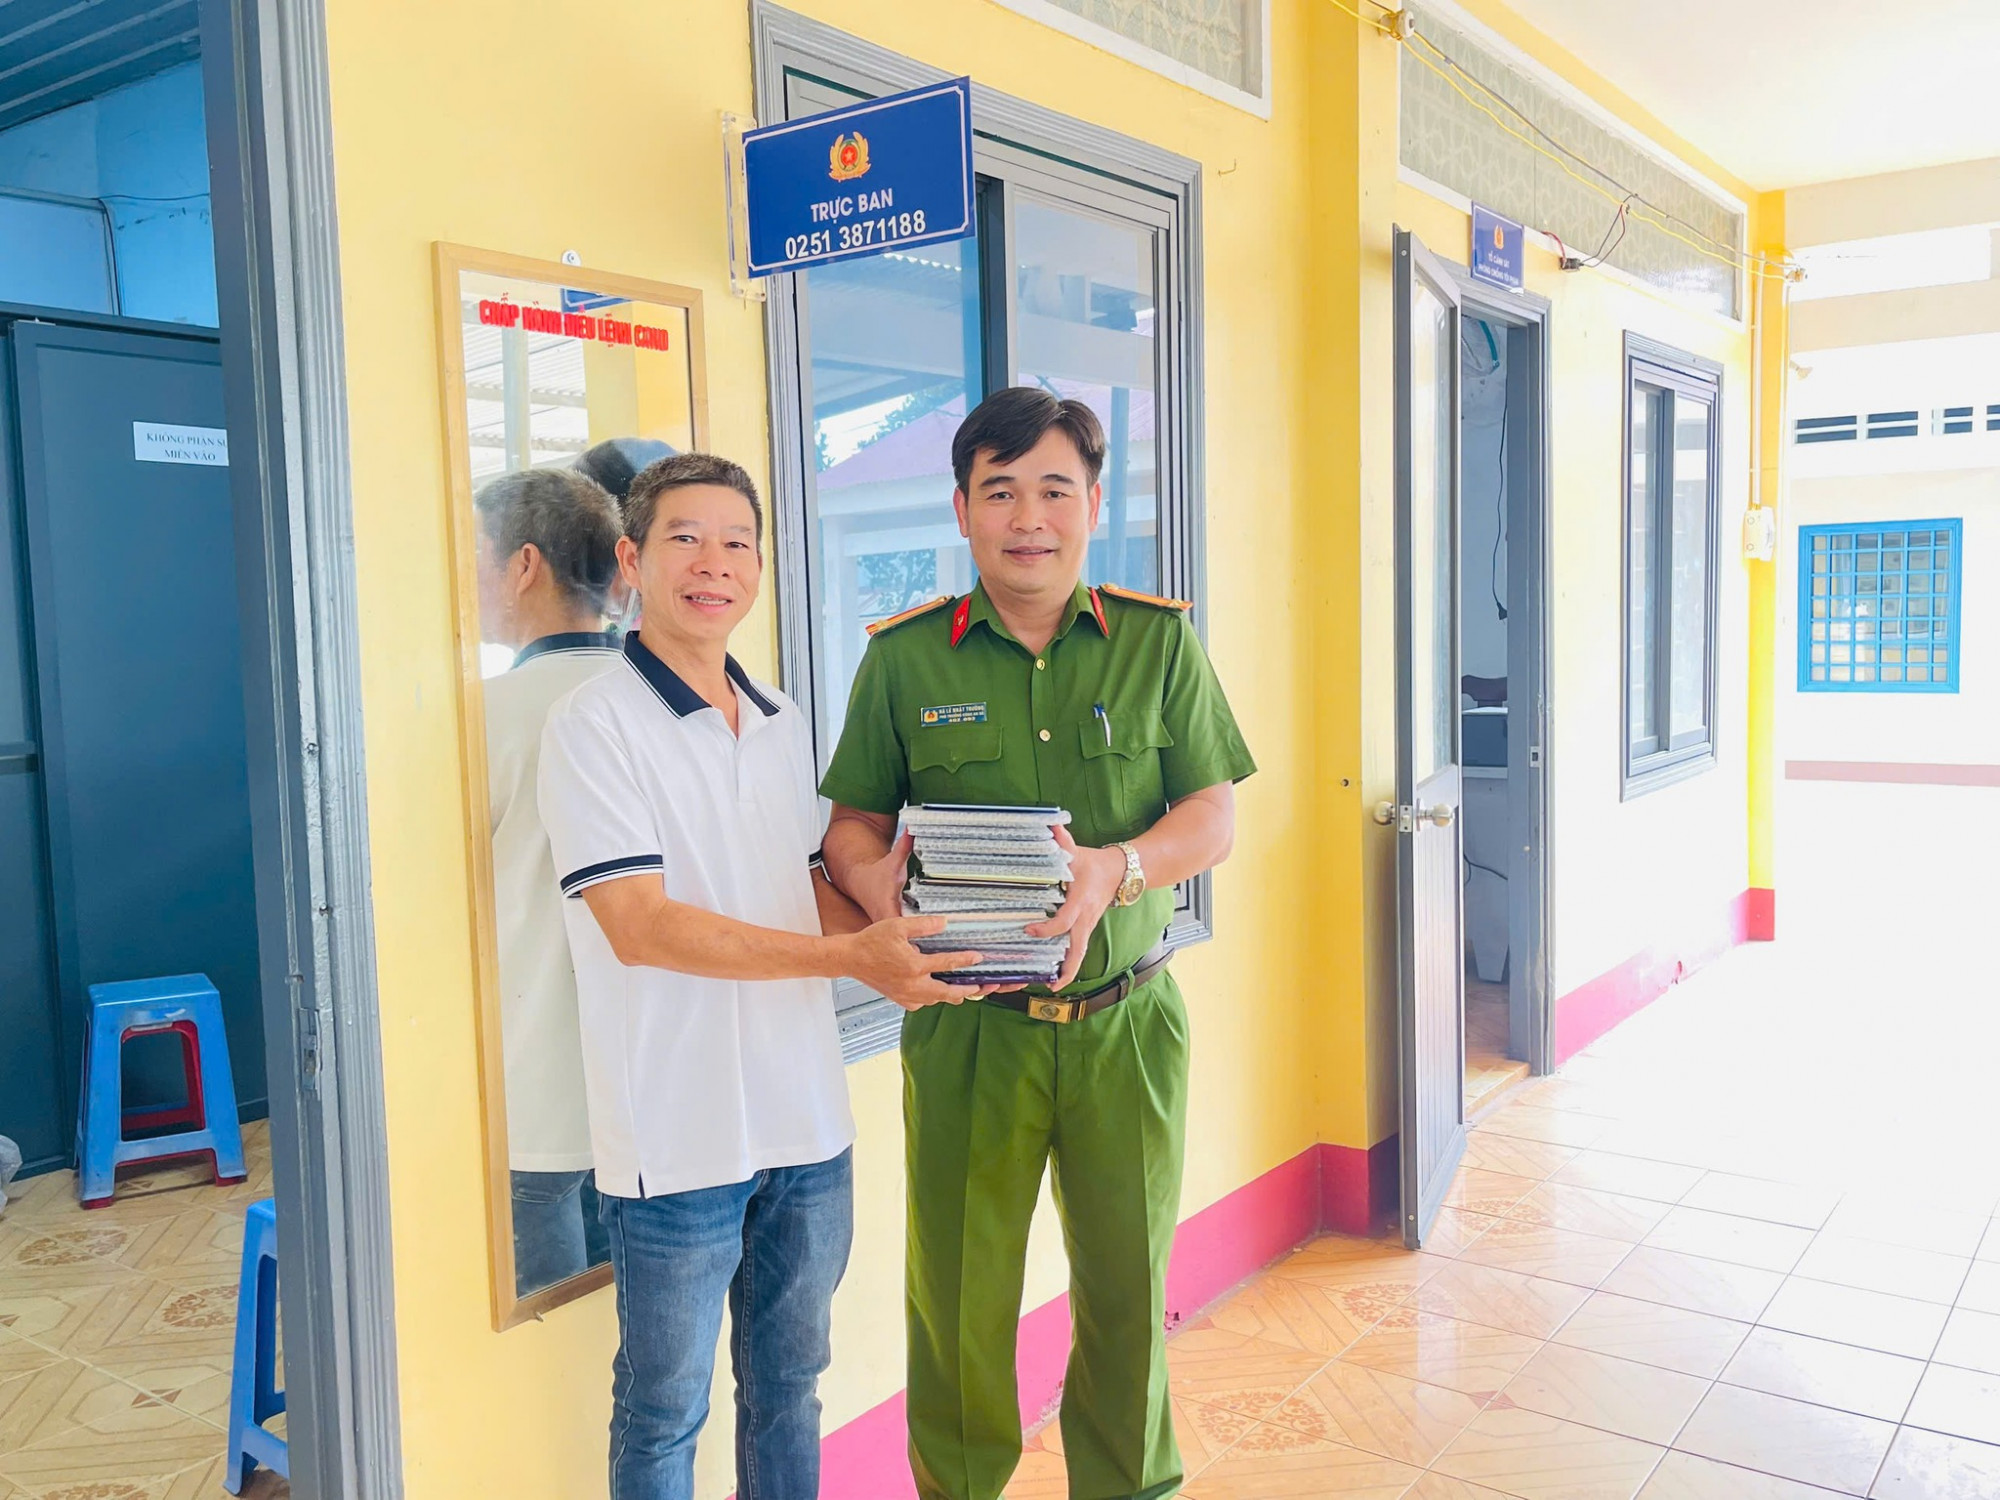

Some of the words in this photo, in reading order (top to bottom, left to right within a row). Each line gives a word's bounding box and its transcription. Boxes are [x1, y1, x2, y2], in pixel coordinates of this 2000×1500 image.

[810, 196, 853, 224] TRỰC
[858, 188, 894, 213] BAN
[785, 229, 831, 260] 0251
[839, 209, 926, 249] 3871188
[146, 432, 185, 444] KHÔNG
